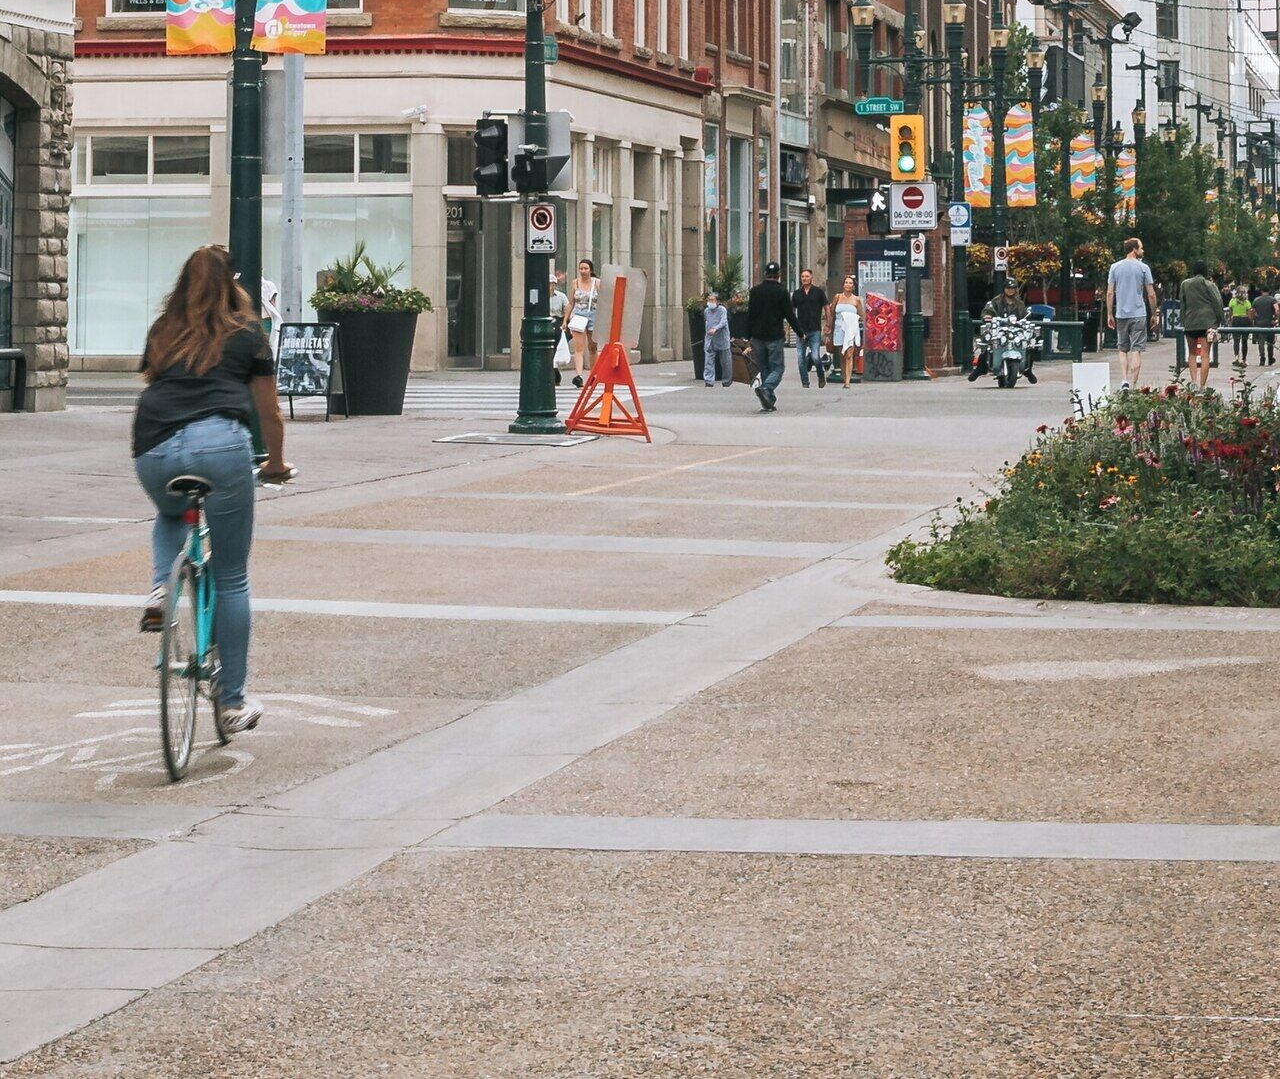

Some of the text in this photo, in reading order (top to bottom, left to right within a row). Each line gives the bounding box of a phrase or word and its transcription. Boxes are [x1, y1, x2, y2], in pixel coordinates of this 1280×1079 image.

[866, 103, 887, 112] STREET
[890, 103, 900, 111] SW
[446, 207, 463, 217] 201
[283, 337, 330, 349] MURRIETA'S
